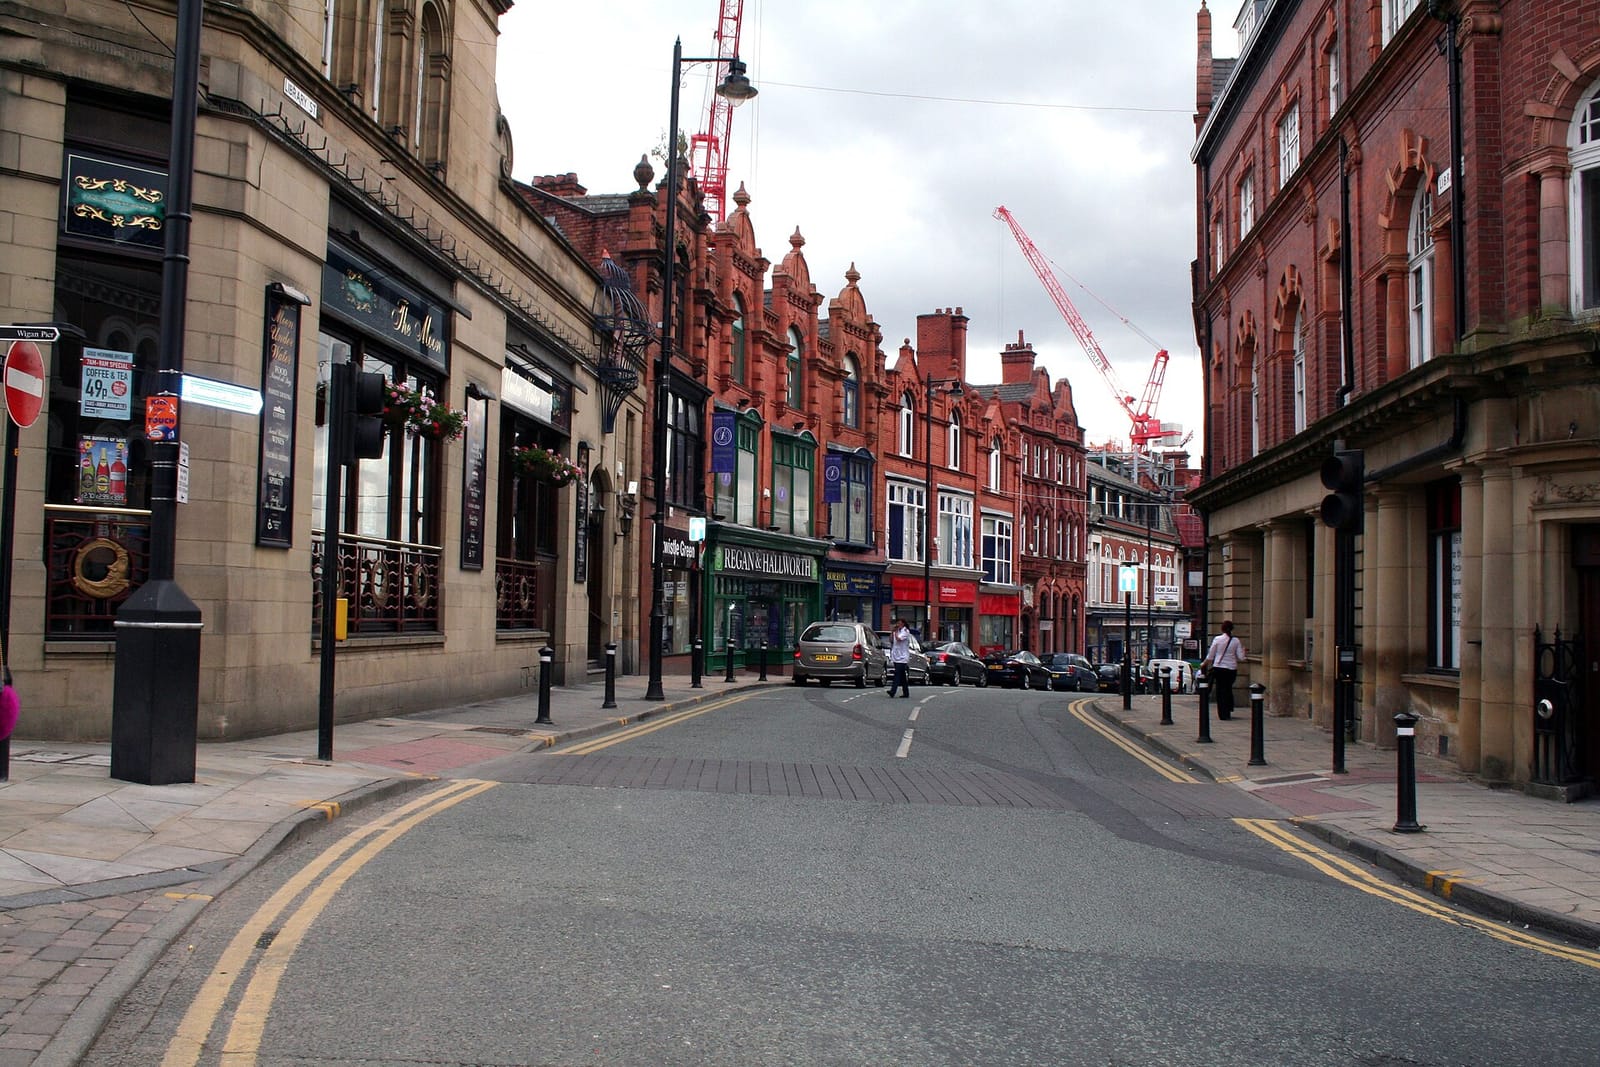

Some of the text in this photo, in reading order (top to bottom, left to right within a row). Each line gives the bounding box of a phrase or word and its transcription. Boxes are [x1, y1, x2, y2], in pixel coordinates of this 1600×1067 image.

[285, 79, 317, 116] LIBRARY ST
[271, 306, 294, 329] Moon
[391, 298, 442, 353] The Moon
[17, 329, 54, 338] Wigan Pier
[271, 324, 293, 347] Under
[271, 343, 292, 365] Water
[1087, 345, 1102, 366] WOLFF
[86, 368, 110, 379] COFFEE
[117, 371, 129, 381] TEA
[110, 362, 129, 370] SPECIAL
[85, 378, 108, 400] 49p
[663, 538, 696, 558] wistle Green
[724, 547, 811, 577] REGAN & HALLWORTH
